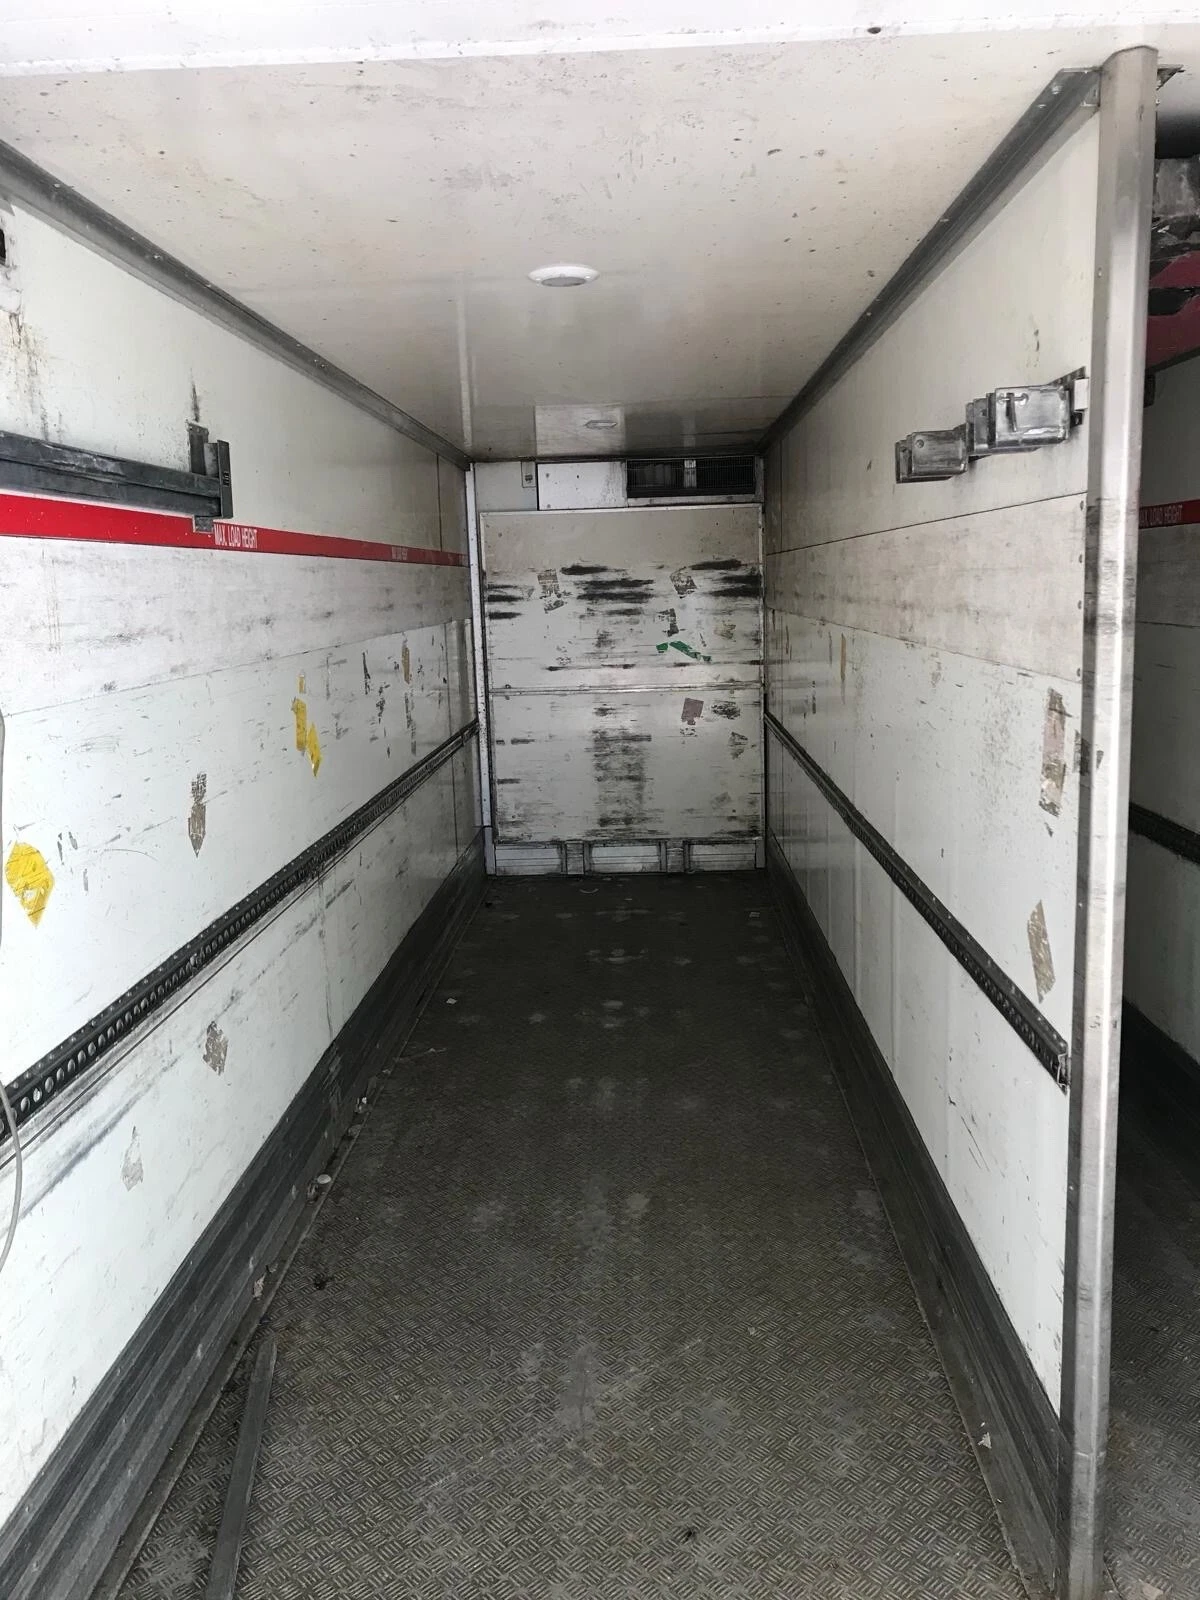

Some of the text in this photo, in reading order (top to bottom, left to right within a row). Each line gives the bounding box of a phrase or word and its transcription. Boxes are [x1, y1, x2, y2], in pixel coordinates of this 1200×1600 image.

[1164, 503, 1183, 525] HEIGHT
[228, 525, 241, 547] LOAD
[241, 527, 258, 549] HEIGHT
